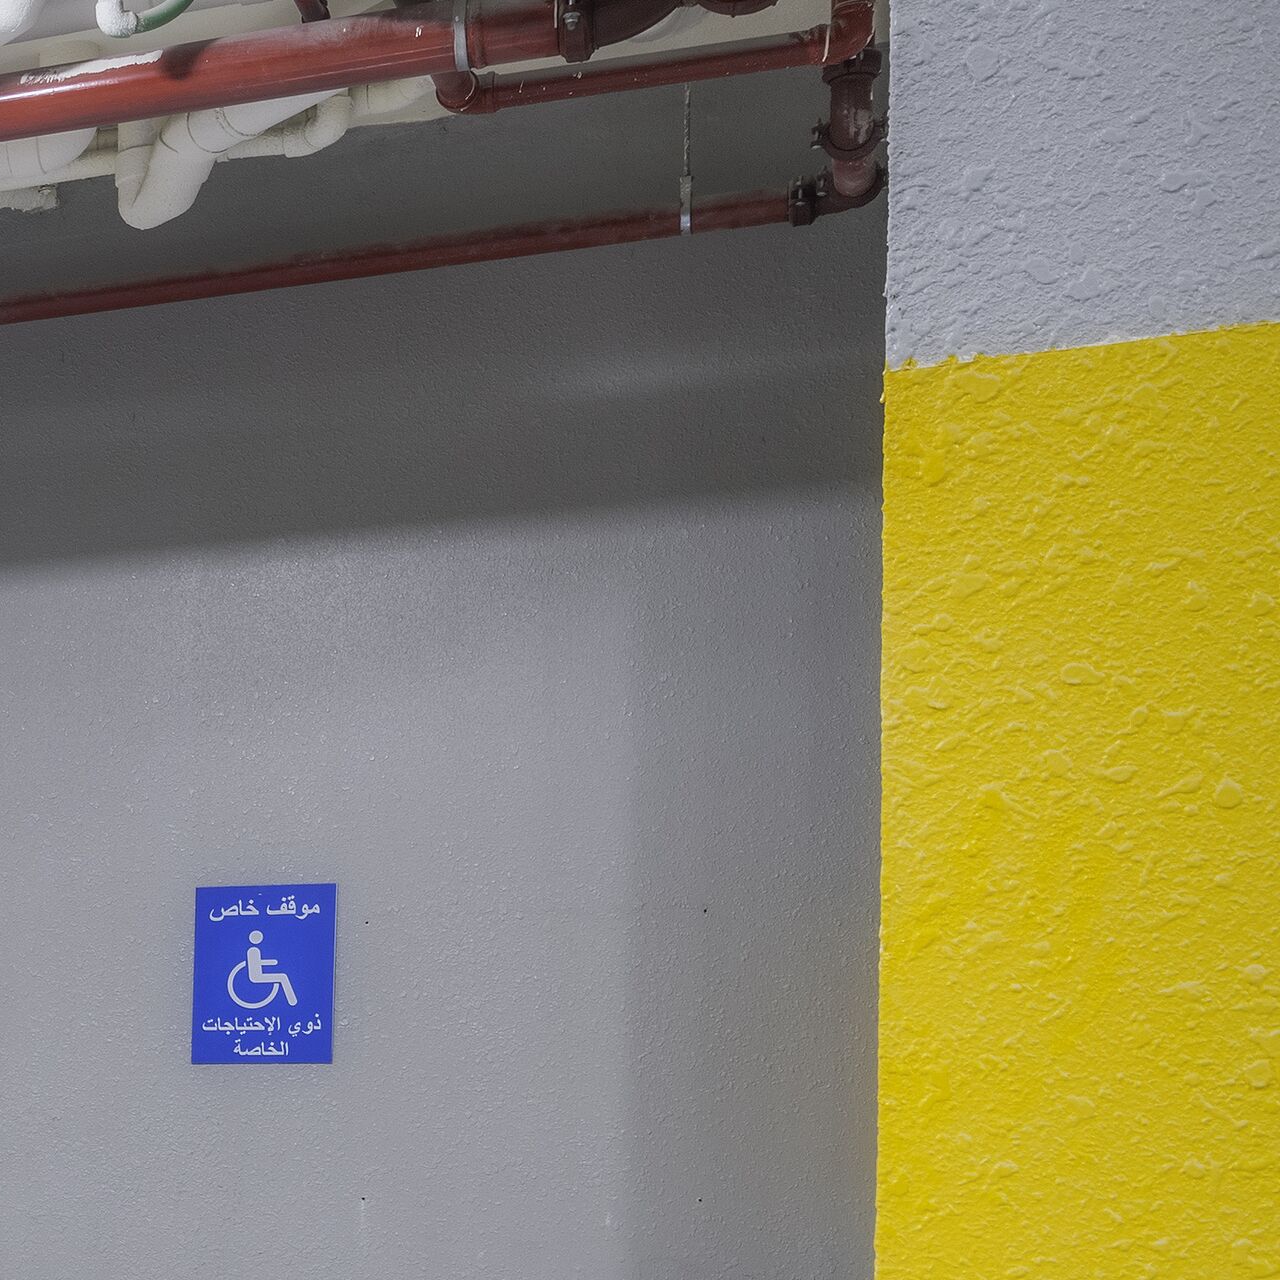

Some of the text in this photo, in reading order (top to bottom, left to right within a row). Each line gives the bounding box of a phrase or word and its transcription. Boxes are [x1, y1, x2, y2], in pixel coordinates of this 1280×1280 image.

[209, 895, 320, 921] موقف خاص
[288, 1013, 321, 1037] ذوي
[233, 1039, 289, 1056] الخاصة
